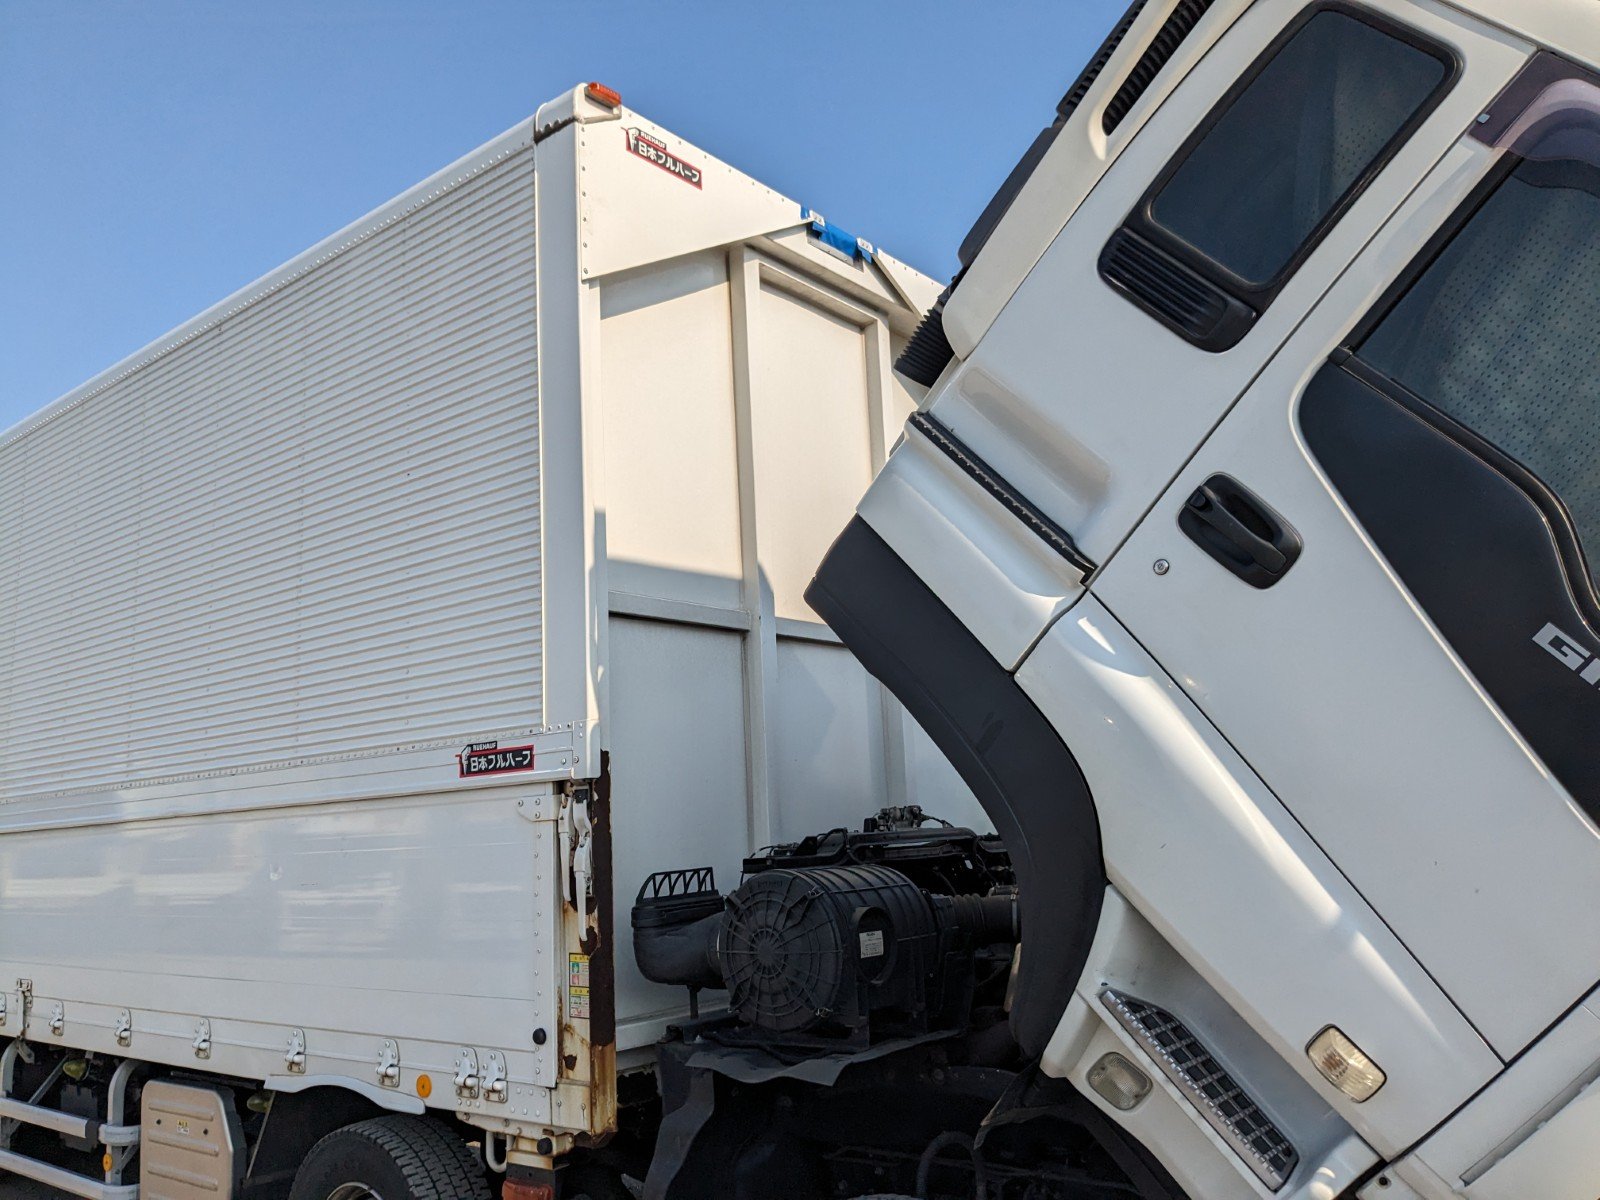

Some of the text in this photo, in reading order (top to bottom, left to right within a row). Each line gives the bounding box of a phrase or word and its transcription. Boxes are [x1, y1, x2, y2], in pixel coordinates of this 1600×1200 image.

[638, 140, 700, 182] 日本フルハーフ
[470, 750, 531, 772] 日本フルハーフ
